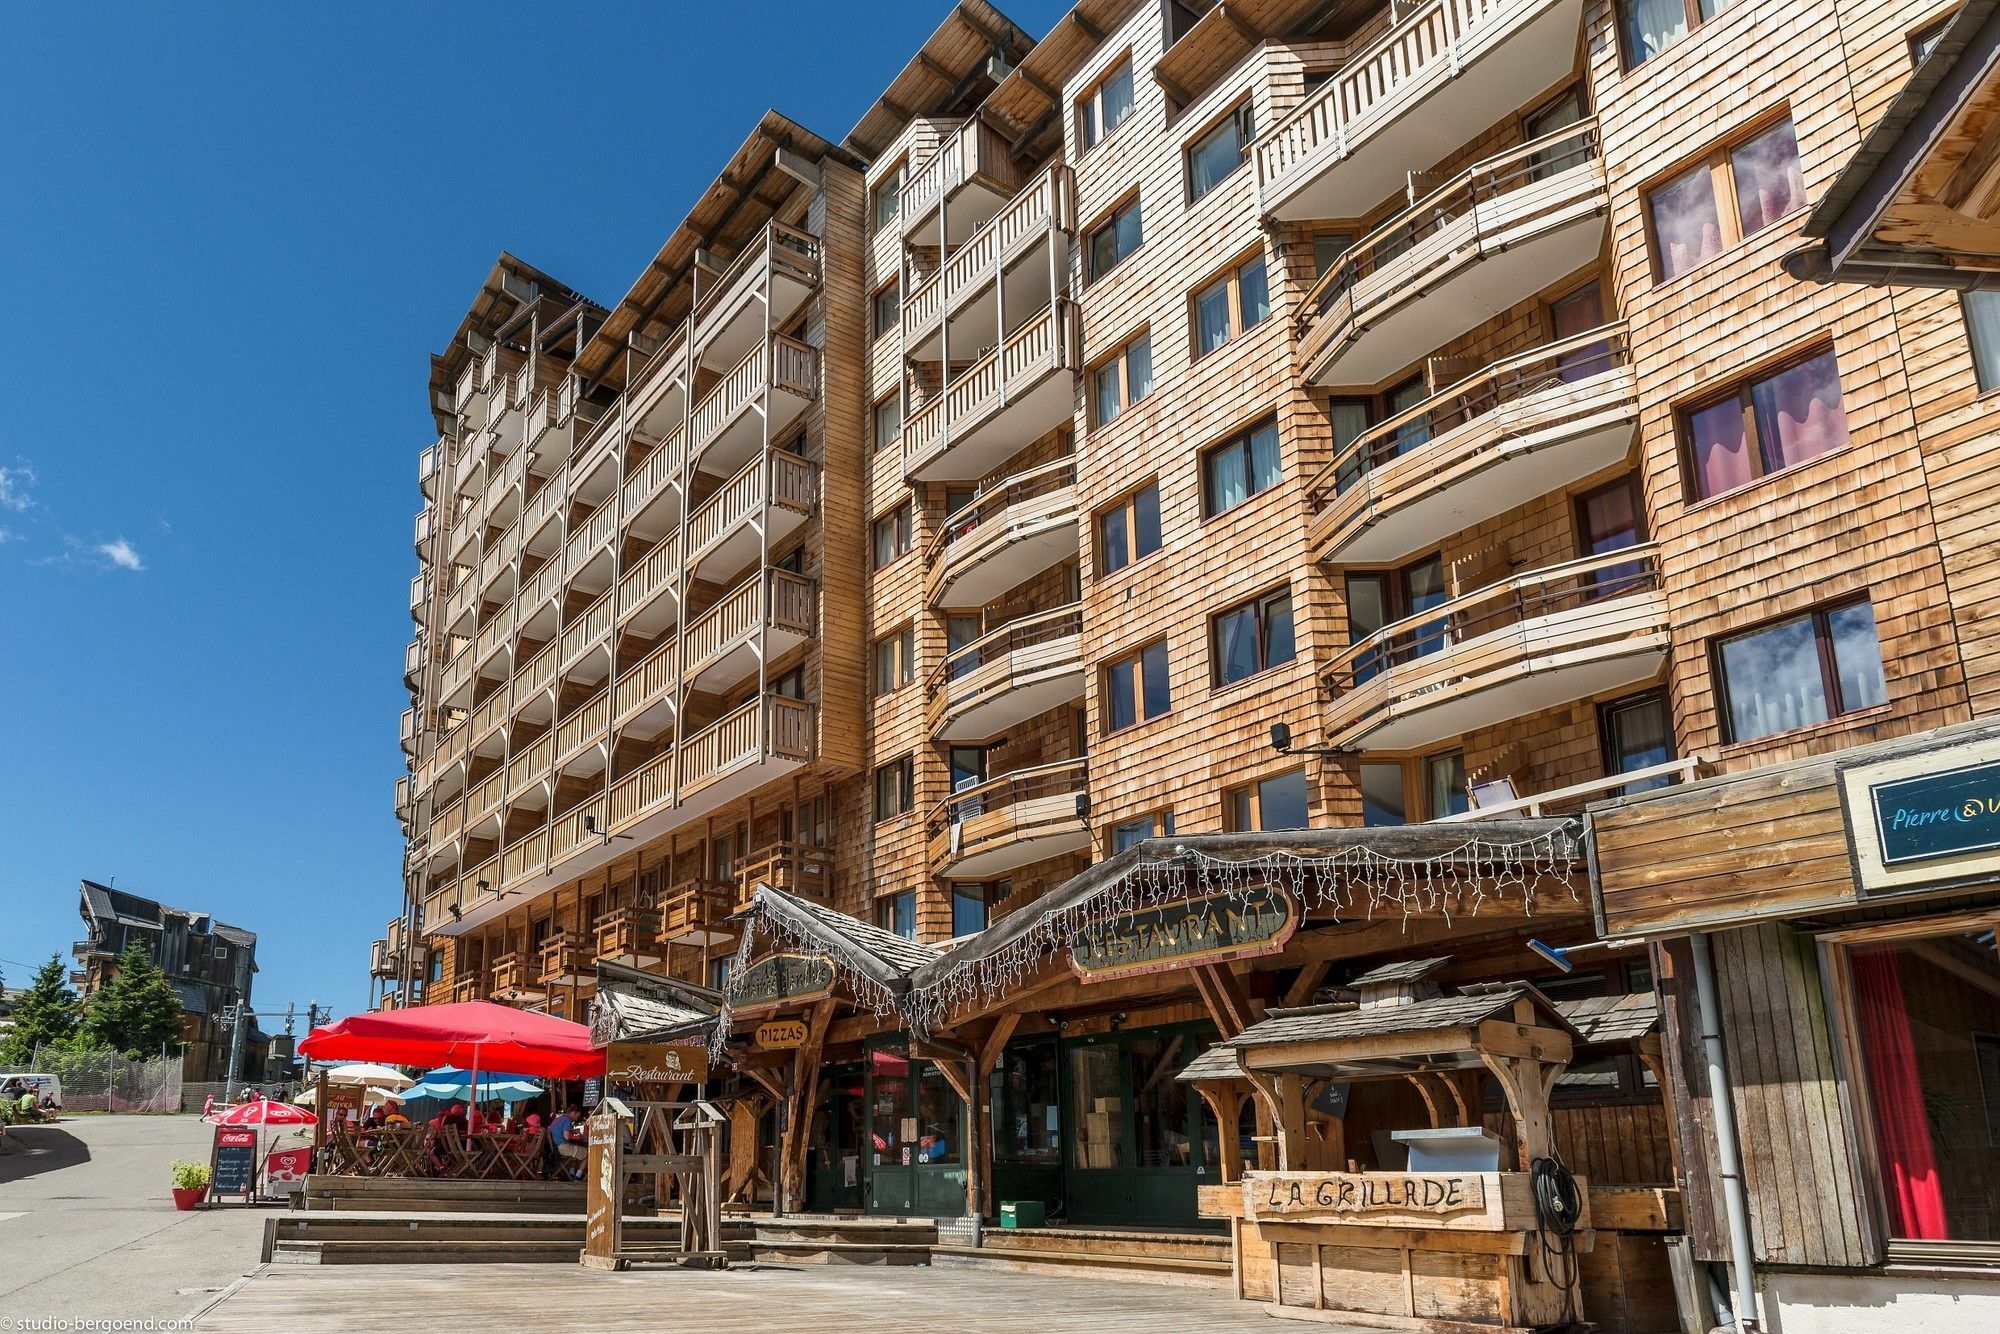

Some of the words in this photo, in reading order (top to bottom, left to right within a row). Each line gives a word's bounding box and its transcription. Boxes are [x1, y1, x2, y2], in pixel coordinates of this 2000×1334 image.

[1892, 807, 1951, 830] Pierre
[760, 1026, 803, 1043] PIZZAS
[626, 1064, 695, 1082] Restaurant
[1269, 1182, 1305, 1207] LA
[1316, 1177, 1463, 1207] GRILLADE
